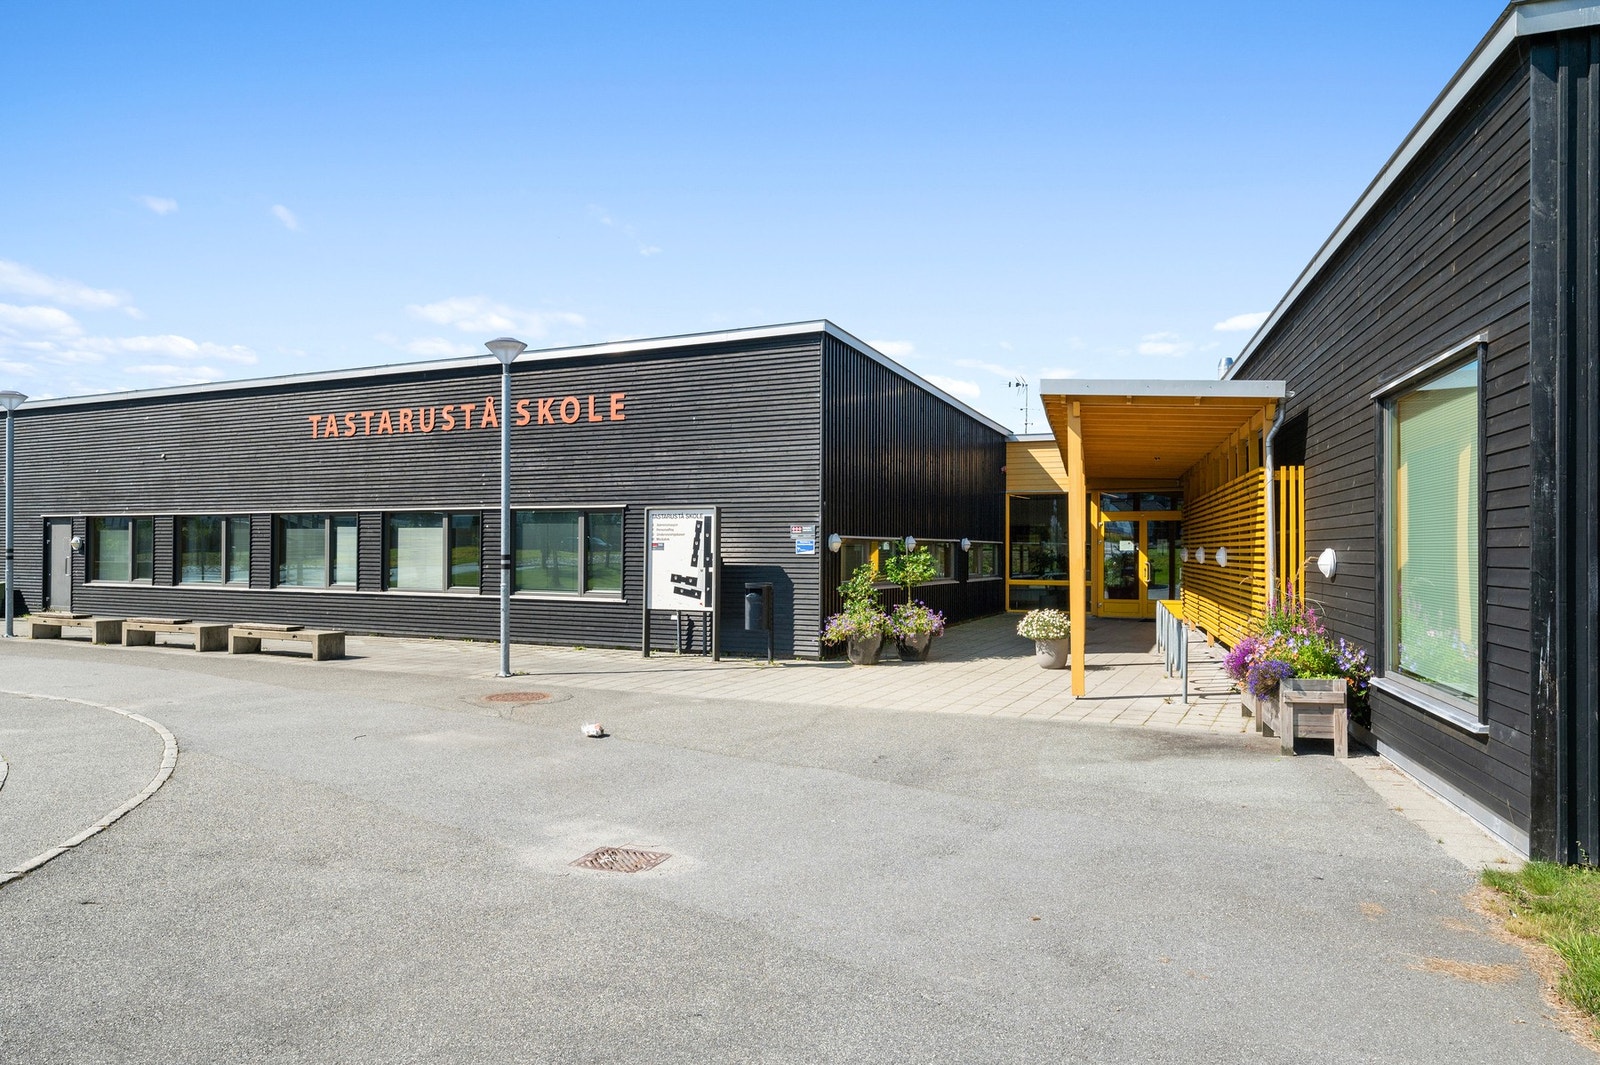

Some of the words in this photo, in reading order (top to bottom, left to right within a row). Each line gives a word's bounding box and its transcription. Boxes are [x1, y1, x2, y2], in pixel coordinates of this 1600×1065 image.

[309, 397, 499, 438] TASTARUSTÅ
[515, 392, 626, 426] SKOLE
[685, 512, 703, 520] SKOLE
